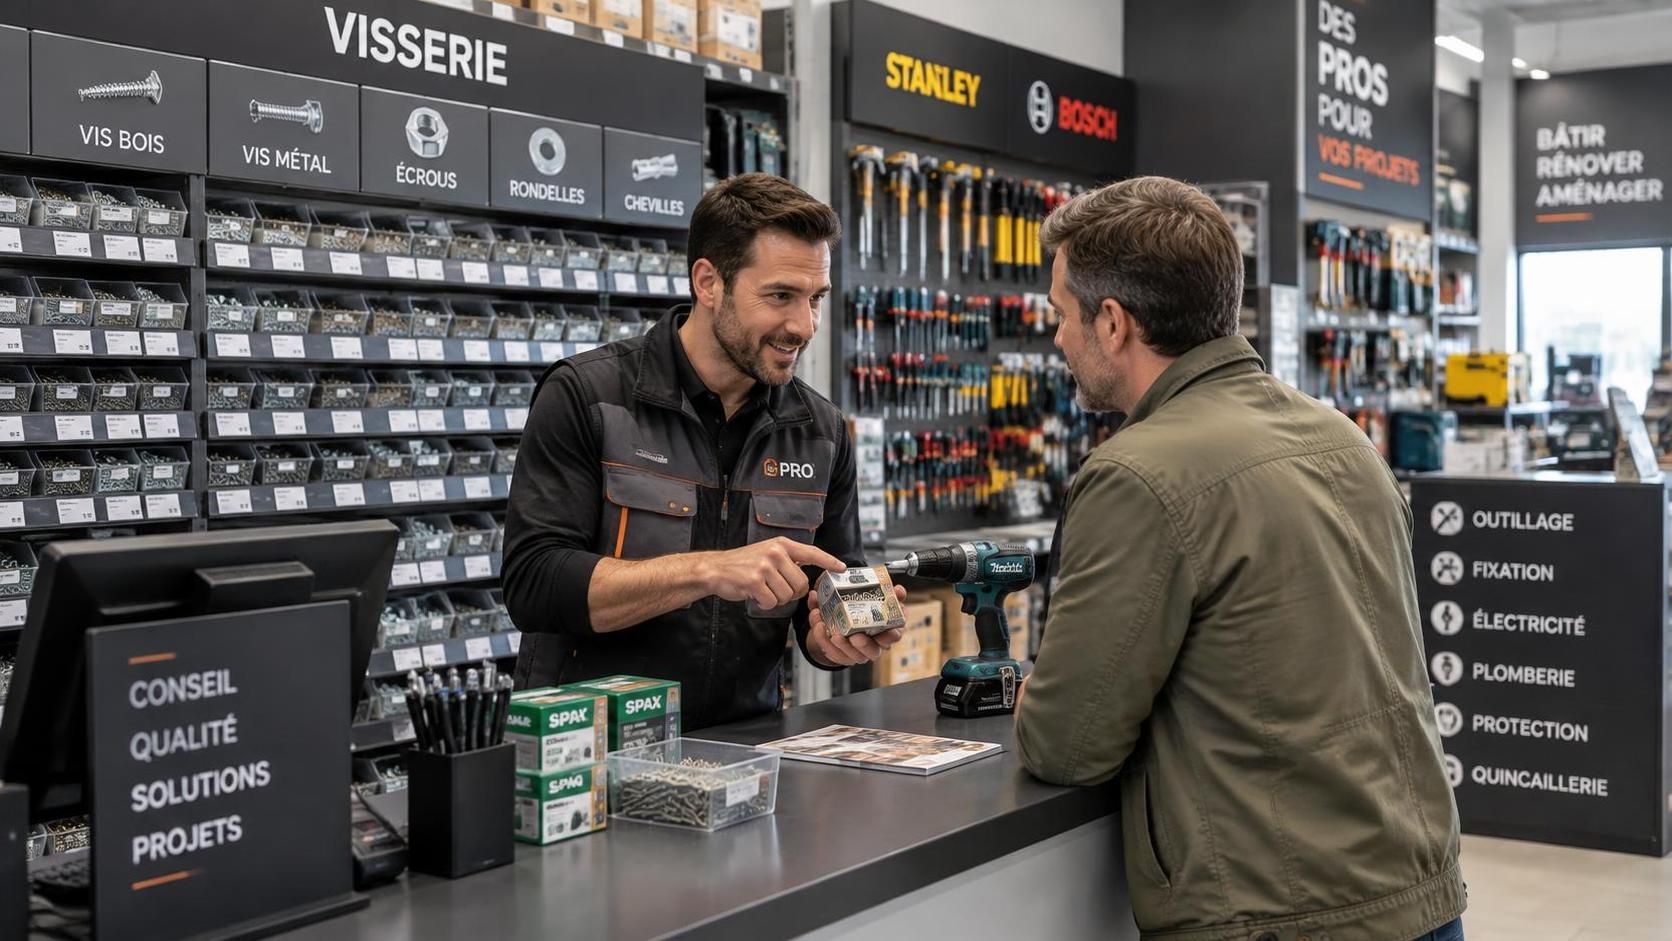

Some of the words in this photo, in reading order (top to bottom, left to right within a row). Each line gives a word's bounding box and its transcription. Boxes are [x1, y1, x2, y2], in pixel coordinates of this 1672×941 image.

[1318, 1, 1356, 43] DES
[325, 7, 508, 86] VISSERIE
[886, 52, 981, 107] STANLEY
[1318, 41, 1388, 107] PROS
[1058, 96, 1117, 140] BOSCH
[1318, 94, 1373, 139] POUR
[80, 124, 113, 147] VIS
[119, 129, 165, 154] BOIS
[1536, 121, 1606, 150] BÂTIR
[242, 145, 270, 166] VIS
[275, 147, 332, 174] MÉTAL
[1318, 135, 1351, 168] VOS
[1354, 144, 1420, 186] PROJETS
[1536, 150, 1645, 179] RÉNOVER
[396, 162, 458, 189] ÉCROUS
[509, 179, 585, 205] RONDELLES
[624, 194, 685, 217] CHEVILLES
[1536, 177, 1663, 207] AMÉNAGER
[780, 462, 814, 479] PRO
[1472, 510, 1574, 532] OUTILLAGE
[1472, 560, 1554, 582] FIXATION
[1472, 608, 1586, 636] ÉLECTRICITÉ
[129, 669, 238, 709] CONSEIL
[1472, 662, 1575, 688] PLOMBERIE
[626, 695, 662, 715] SPAX
[130, 713, 238, 762] QUALITÉ
[1472, 714, 1589, 742] PROTECTION
[131, 760, 271, 812] SOLUTIONS
[1471, 765, 1608, 797] QUINCAILLERIE
[132, 815, 243, 864] PROJETS
